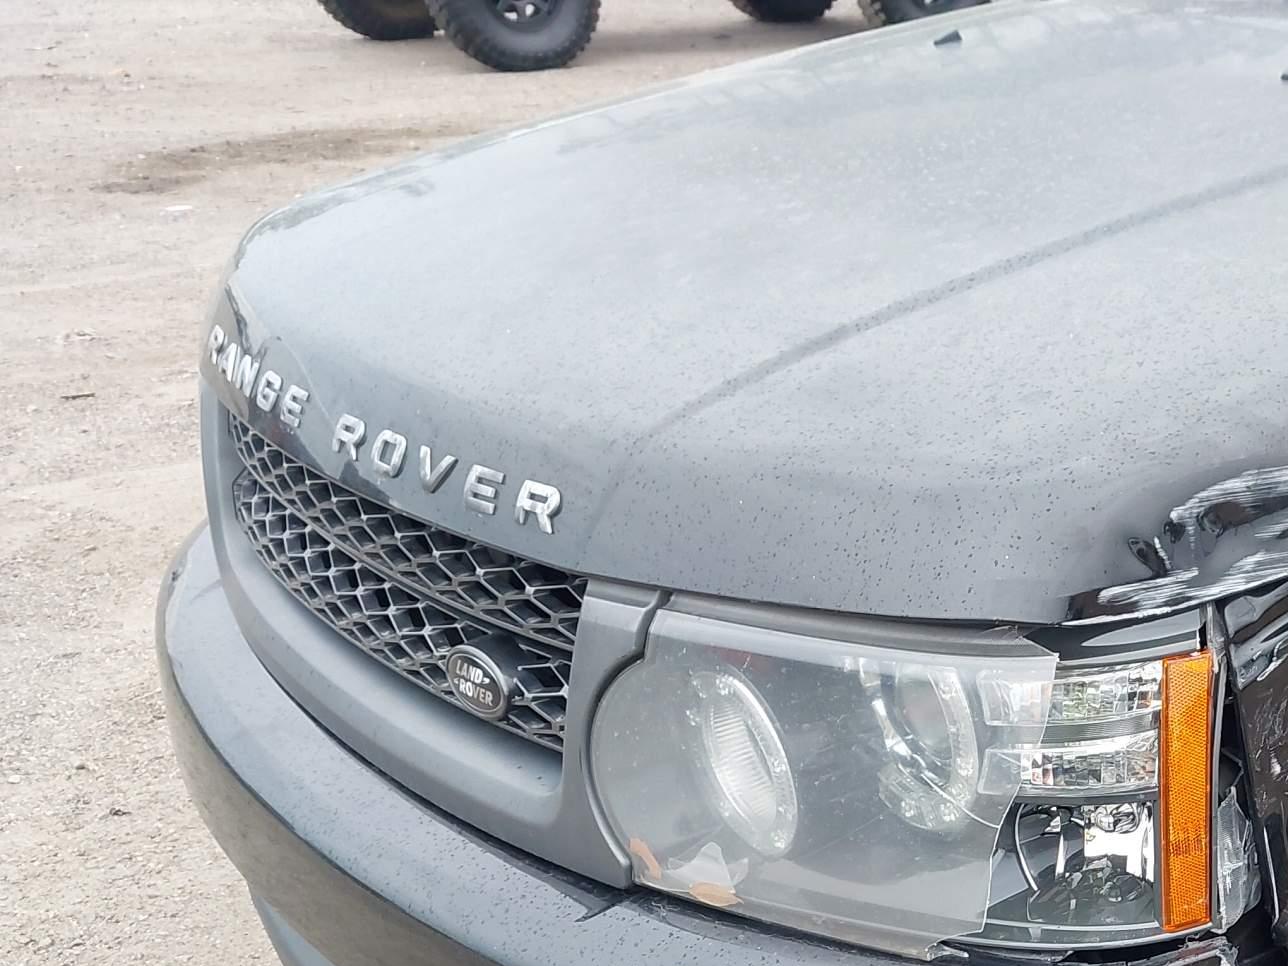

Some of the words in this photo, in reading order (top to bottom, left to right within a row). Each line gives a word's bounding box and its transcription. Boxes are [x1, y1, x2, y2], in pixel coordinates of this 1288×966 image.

[206, 323, 311, 428] RANGE
[331, 412, 564, 536] ROVER
[455, 659, 485, 684] LAND
[458, 680, 494, 706] ROVER
